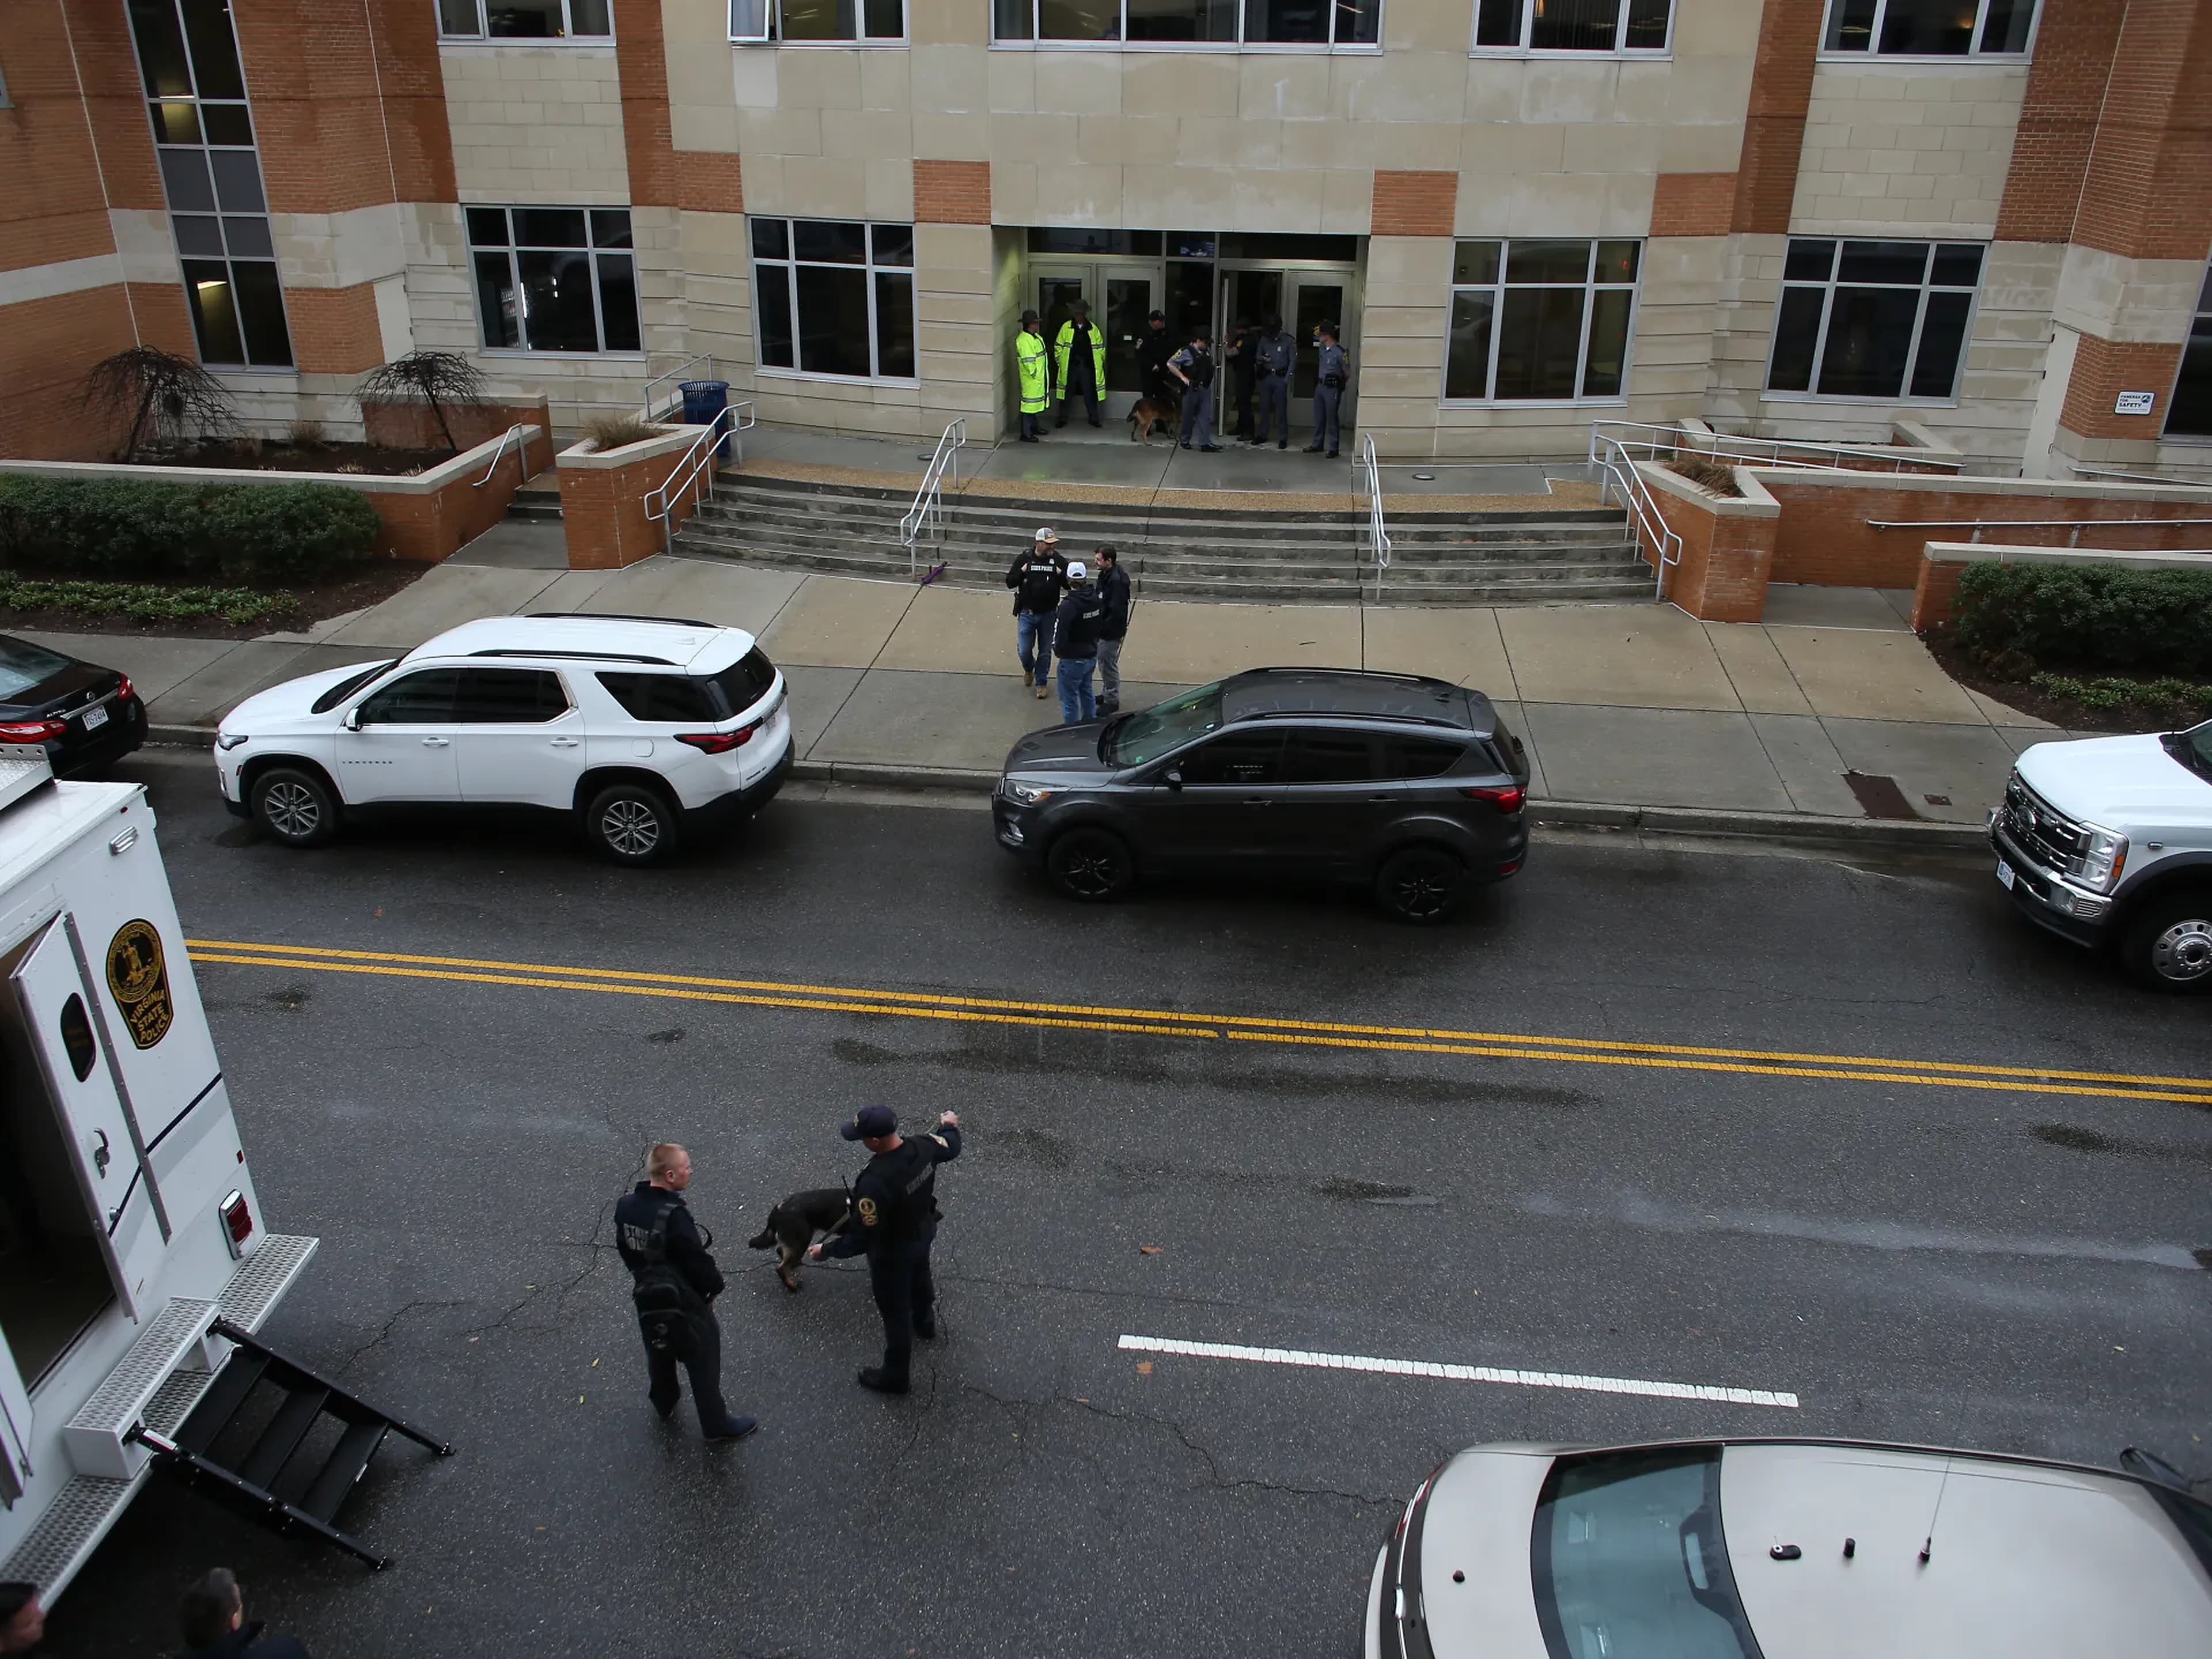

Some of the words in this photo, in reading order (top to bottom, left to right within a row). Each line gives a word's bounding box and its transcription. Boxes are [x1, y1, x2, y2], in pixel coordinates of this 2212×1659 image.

[130, 990, 165, 1023] VIRGINIA
[138, 1003, 163, 1031] STATE
[141, 1013, 169, 1043] POLICE
